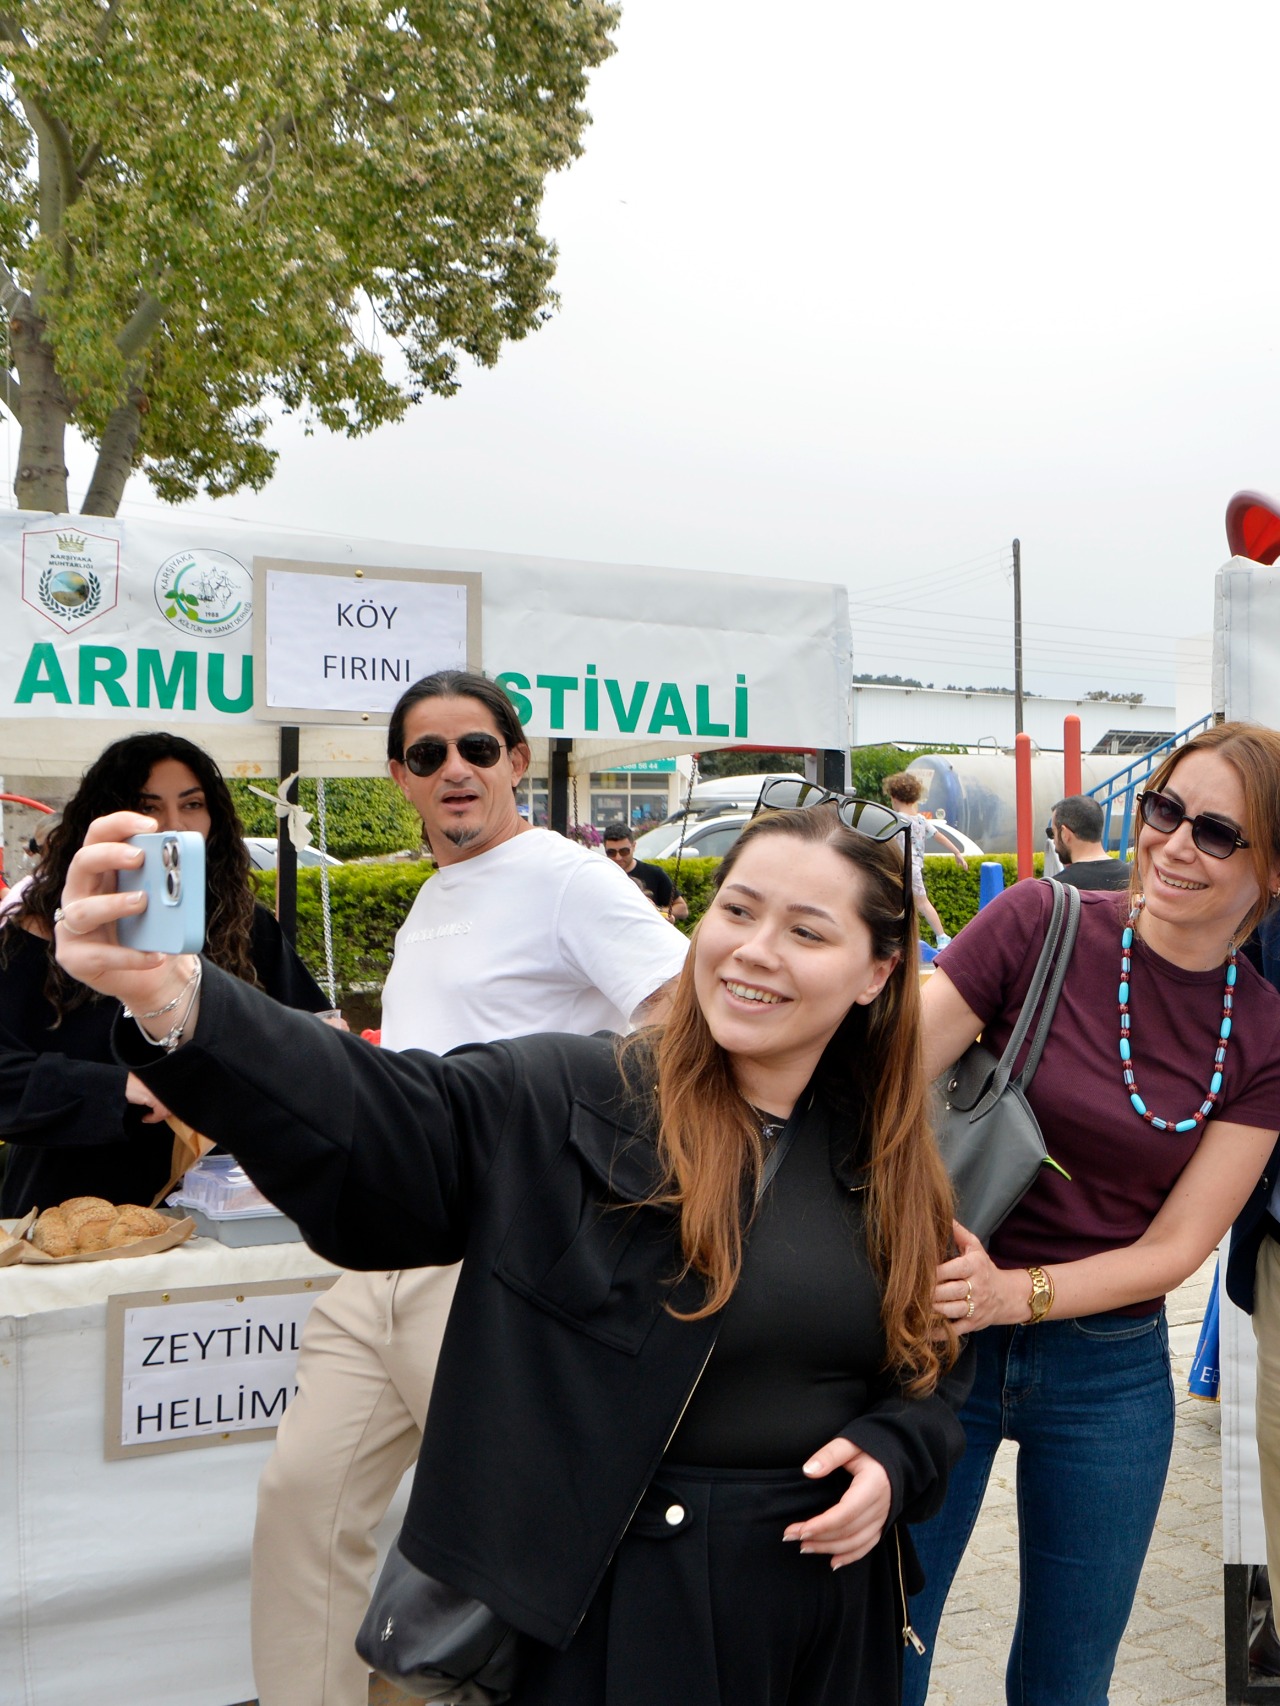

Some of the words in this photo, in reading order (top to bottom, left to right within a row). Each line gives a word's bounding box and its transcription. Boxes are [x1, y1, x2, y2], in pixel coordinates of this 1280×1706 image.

[161, 553, 194, 590] KARŞIYAKA
[337, 599, 398, 630] KÖY
[323, 654, 410, 683] FIRINI
[14, 642, 253, 714] ARMU
[482, 663, 748, 738] STİVALİ
[136, 1384, 299, 1435] HELLİM
